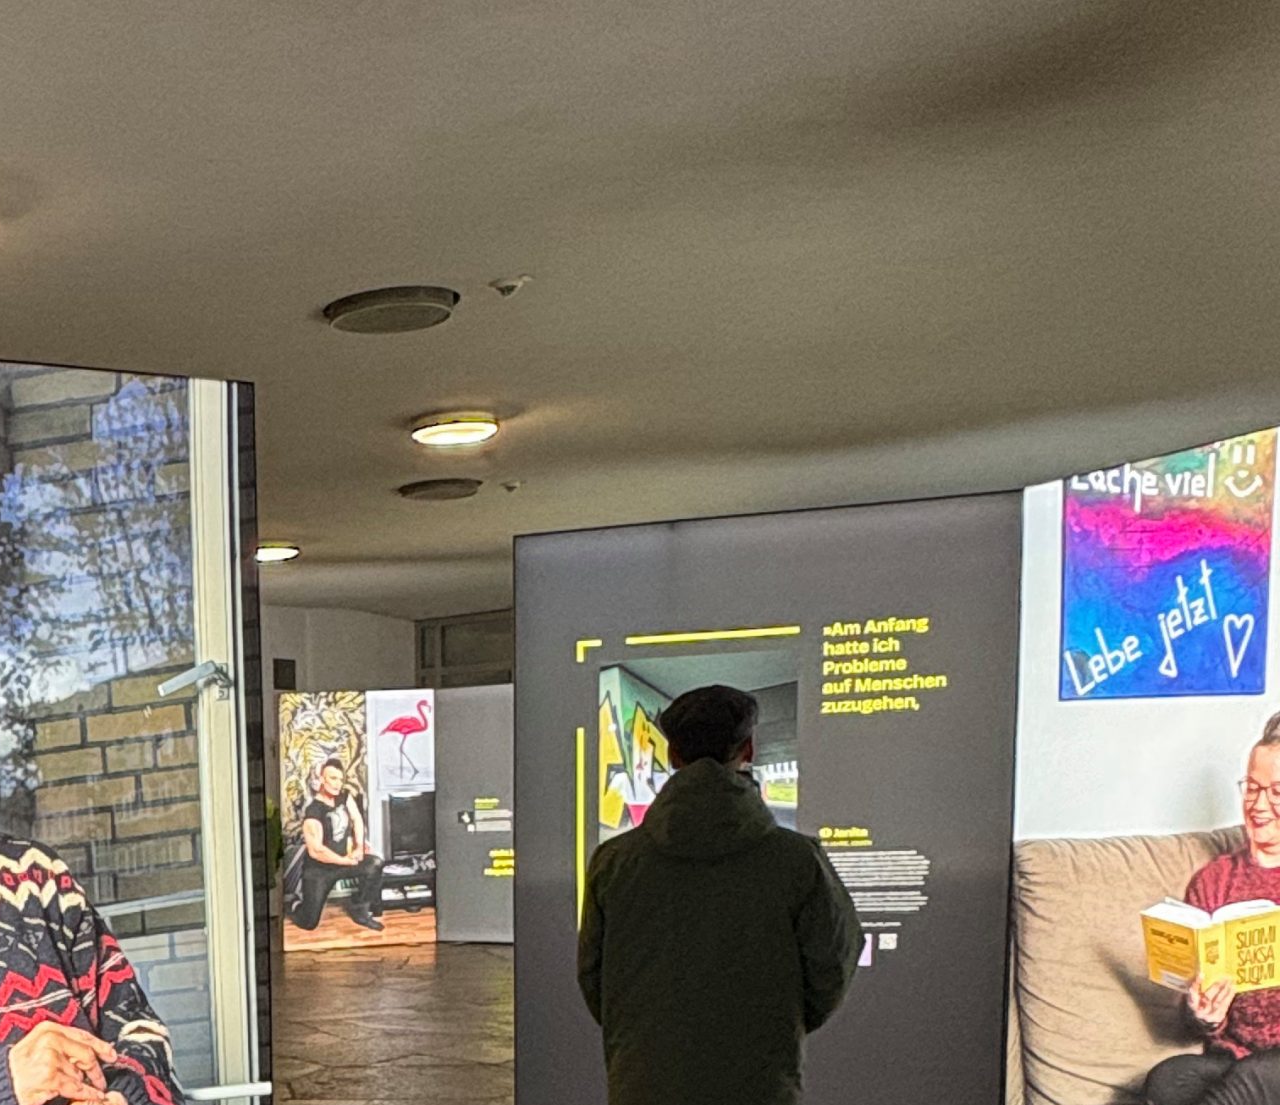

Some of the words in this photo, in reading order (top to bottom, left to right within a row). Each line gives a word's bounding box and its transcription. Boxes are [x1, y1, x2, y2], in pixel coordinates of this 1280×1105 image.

[1164, 452, 1216, 498] viel
[864, 617, 929, 634] Anfang
[1064, 627, 1143, 696] Lebe
[1157, 559, 1217, 678] jetzt
[823, 641, 870, 656] hatte
[872, 637, 900, 653] ich
[823, 658, 907, 676] Probleme
[822, 679, 852, 695] auf
[854, 674, 947, 693] Menschen
[821, 695, 920, 714] zuzugehen,
[1236, 925, 1276, 949] SUOMI
[1237, 945, 1275, 967] SAKSA
